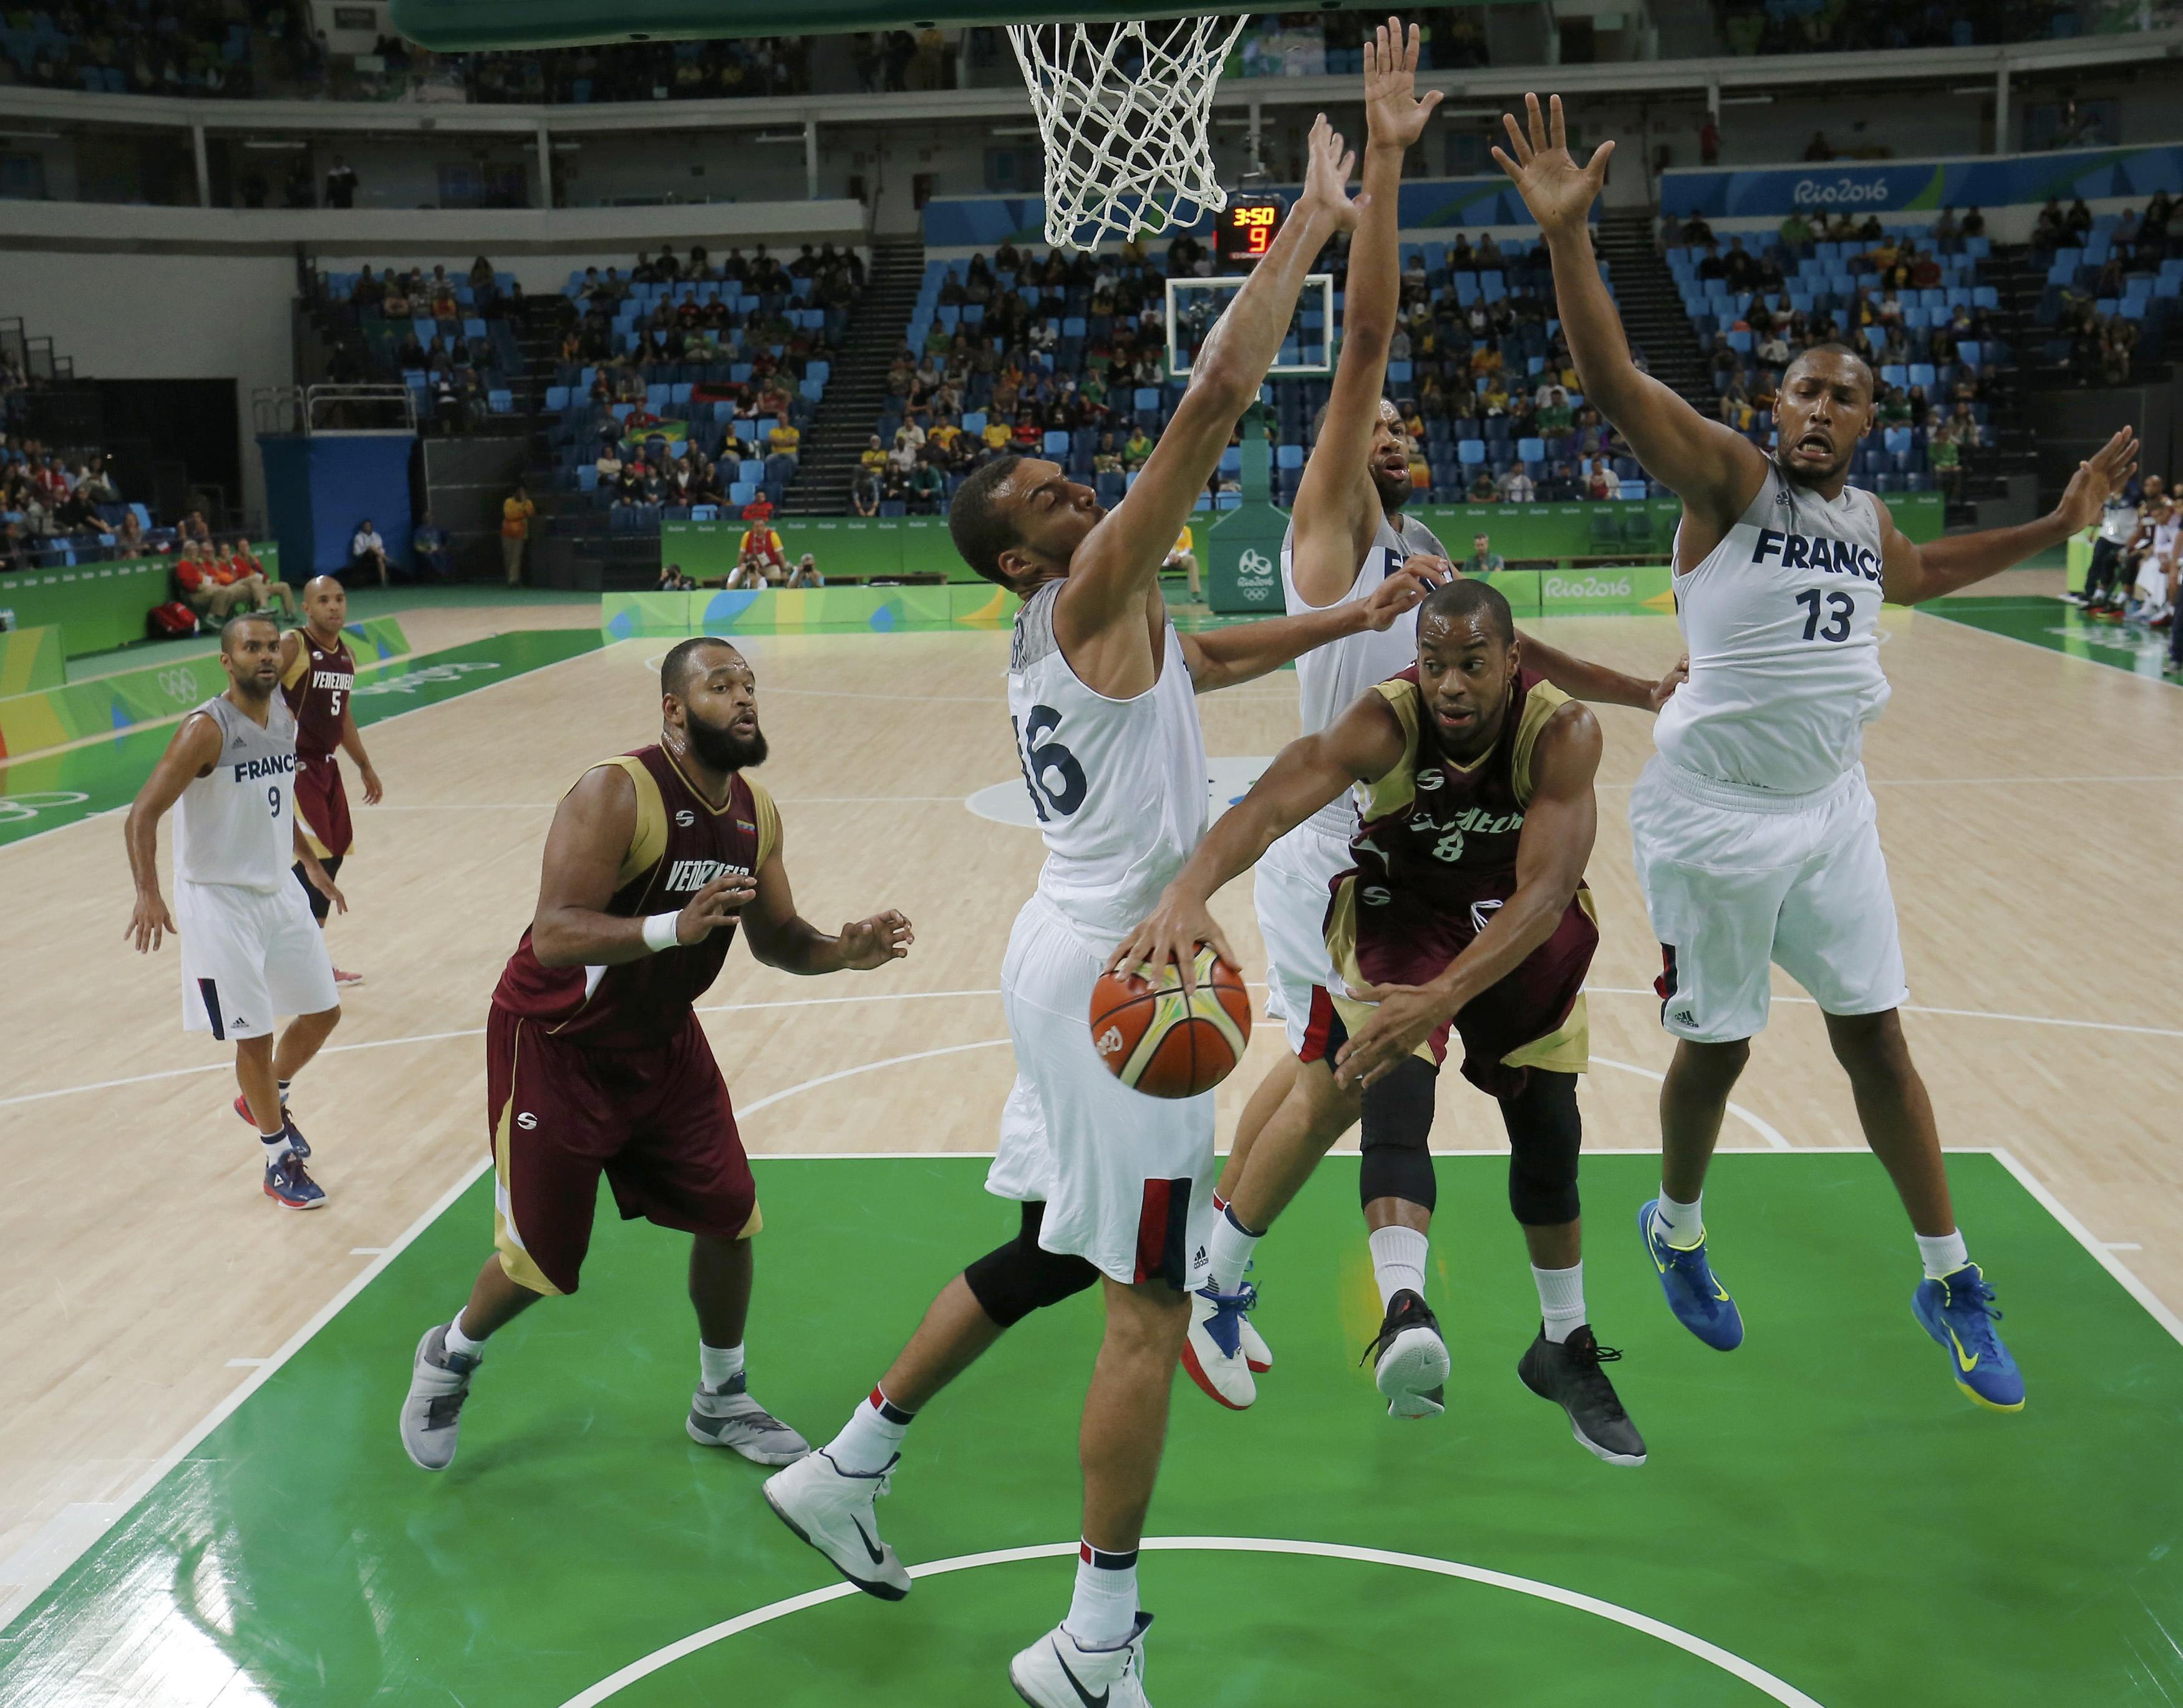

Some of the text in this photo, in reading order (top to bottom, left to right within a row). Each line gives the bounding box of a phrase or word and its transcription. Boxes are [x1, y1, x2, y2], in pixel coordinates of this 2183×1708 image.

[1794, 178, 1888, 203] Rio2016
[1233, 207, 1275, 226] 3:50
[1249, 227, 1267, 252] 9
[1545, 576, 1631, 598] Rio2016
[1795, 588, 1855, 642] 13
[331, 691, 341, 716] 5
[268, 786, 280, 818] 9
[1432, 829, 1464, 862] 8
